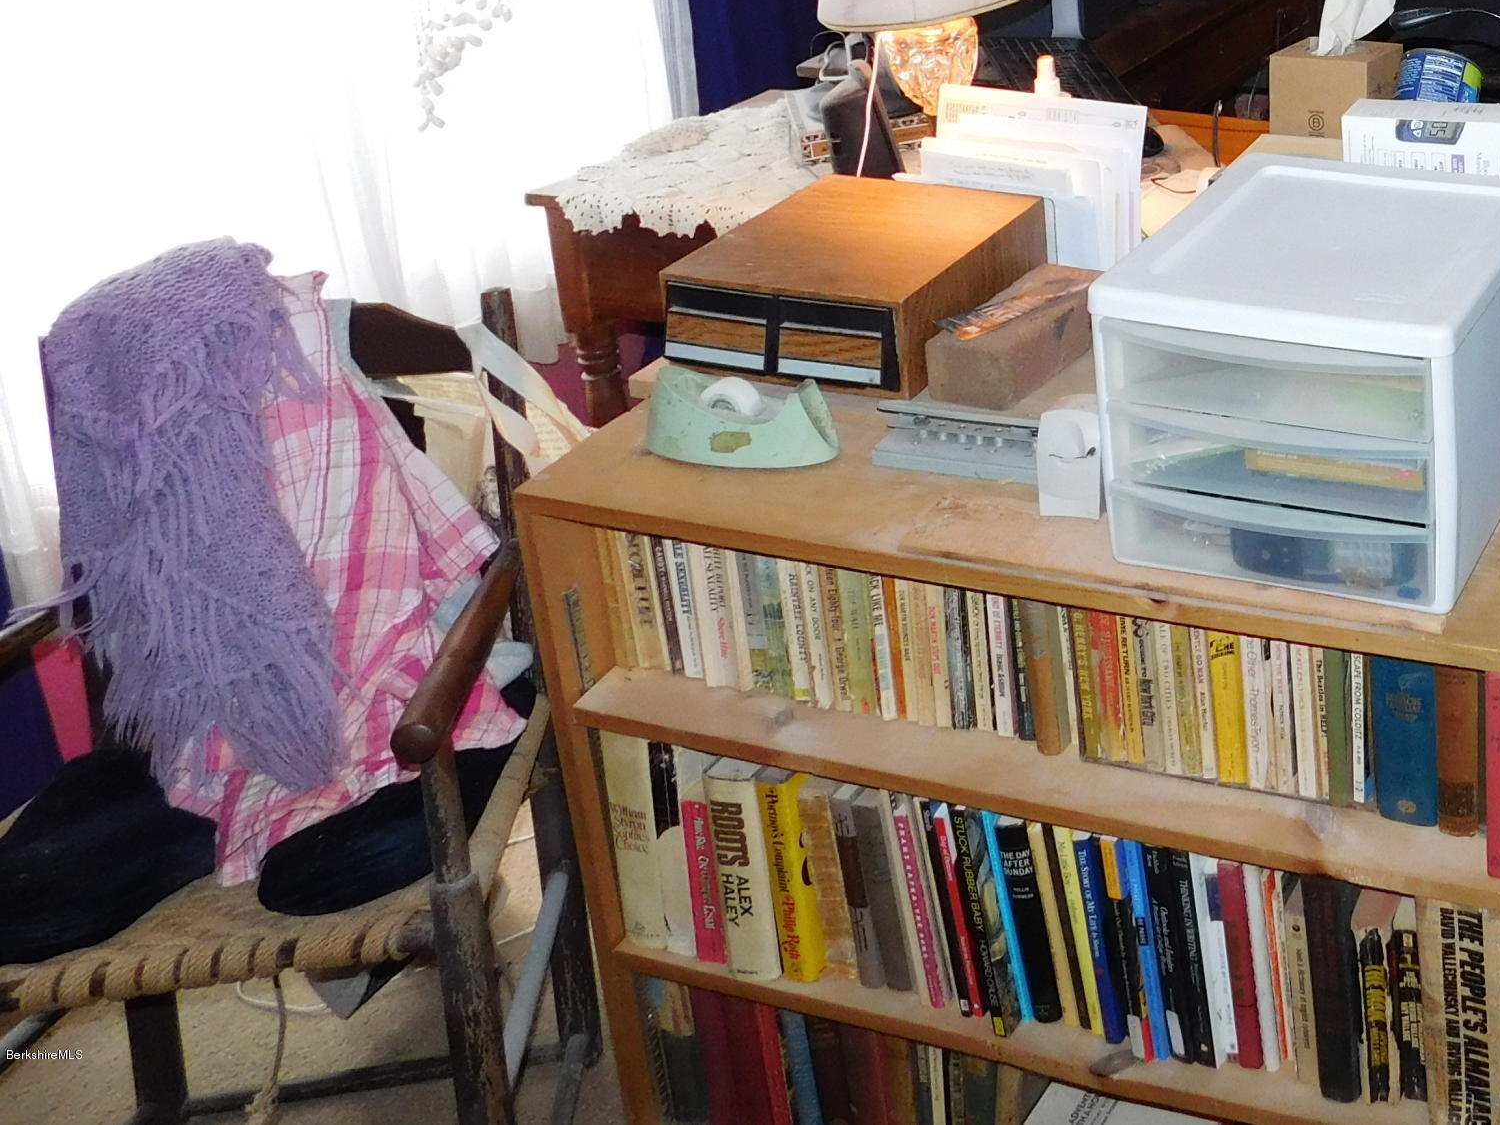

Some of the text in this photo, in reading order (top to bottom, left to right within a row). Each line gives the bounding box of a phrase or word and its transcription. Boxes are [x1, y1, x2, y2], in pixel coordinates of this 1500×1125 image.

[1312, 117, 1320, 128] B
[654, 546, 666, 572] CANDY
[673, 562, 693, 615] SEXUALITY
[702, 563, 720, 612] SEXUALITY
[806, 580, 822, 640] ON ANY DOOR
[869, 594, 883, 611] LIKE
[928, 606, 937, 619] DON
[787, 573, 808, 663] RAINTREE COUNTY
[872, 614, 884, 626] ME
[929, 621, 939, 643] MARTIN
[991, 620, 1005, 649] ETERNITY
[1074, 625, 1088, 665] HENRY'S
[833, 647, 848, 674] George
[1120, 637, 1131, 675] RETURN
[1160, 644, 1168, 656] OF
[1195, 654, 1203, 665] GO
[1079, 669, 1091, 690] NEW
[1161, 659, 1170, 678] TWO
[1196, 667, 1204, 684] MAN
[1315, 660, 1323, 673] The
[839, 677, 851, 700] Orwell
[1163, 681, 1173, 711] CITIES
[1199, 691, 1207, 706] Alan
[1316, 674, 1326, 702] Beatles
[1351, 655, 1364, 740] SCAPE FROM COLDITZ
[1081, 694, 1093, 719] YORK
[1248, 687, 1262, 726] Thomas
[1318, 704, 1326, 712] in
[1248, 726, 1263, 753] Tryon
[709, 801, 751, 867] ROOTS
[1000, 849, 1030, 860] THE DAY
[1003, 859, 1030, 867] AFTER
[1077, 849, 1089, 864] THE
[763, 793, 803, 960] Portnoy's Complaint Philip Roth
[904, 864, 918, 901] KAFKA
[1079, 866, 1092, 888] STORY
[720, 873, 740, 928] HALEY
[735, 875, 754, 918] ALEX
[1085, 901, 1096, 913] MY
[1175, 879, 1195, 917] THINKING
[952, 816, 999, 1007] STUCK RUBBER BABY HOWARD CRUSE
[1088, 915, 1099, 931] LIFE
[1439, 907, 1455, 939] DAVID
[1456, 910, 1484, 946] THE
[1364, 965, 1385, 988] THE
[1441, 942, 1459, 1018] WALLECHINSKY
[1458, 947, 1489, 1033] PEOPLE'S
[1365, 989, 1387, 1023] MAN
[1445, 1018, 1460, 1038] AND
[1446, 1041, 1461, 1076] IRVING
